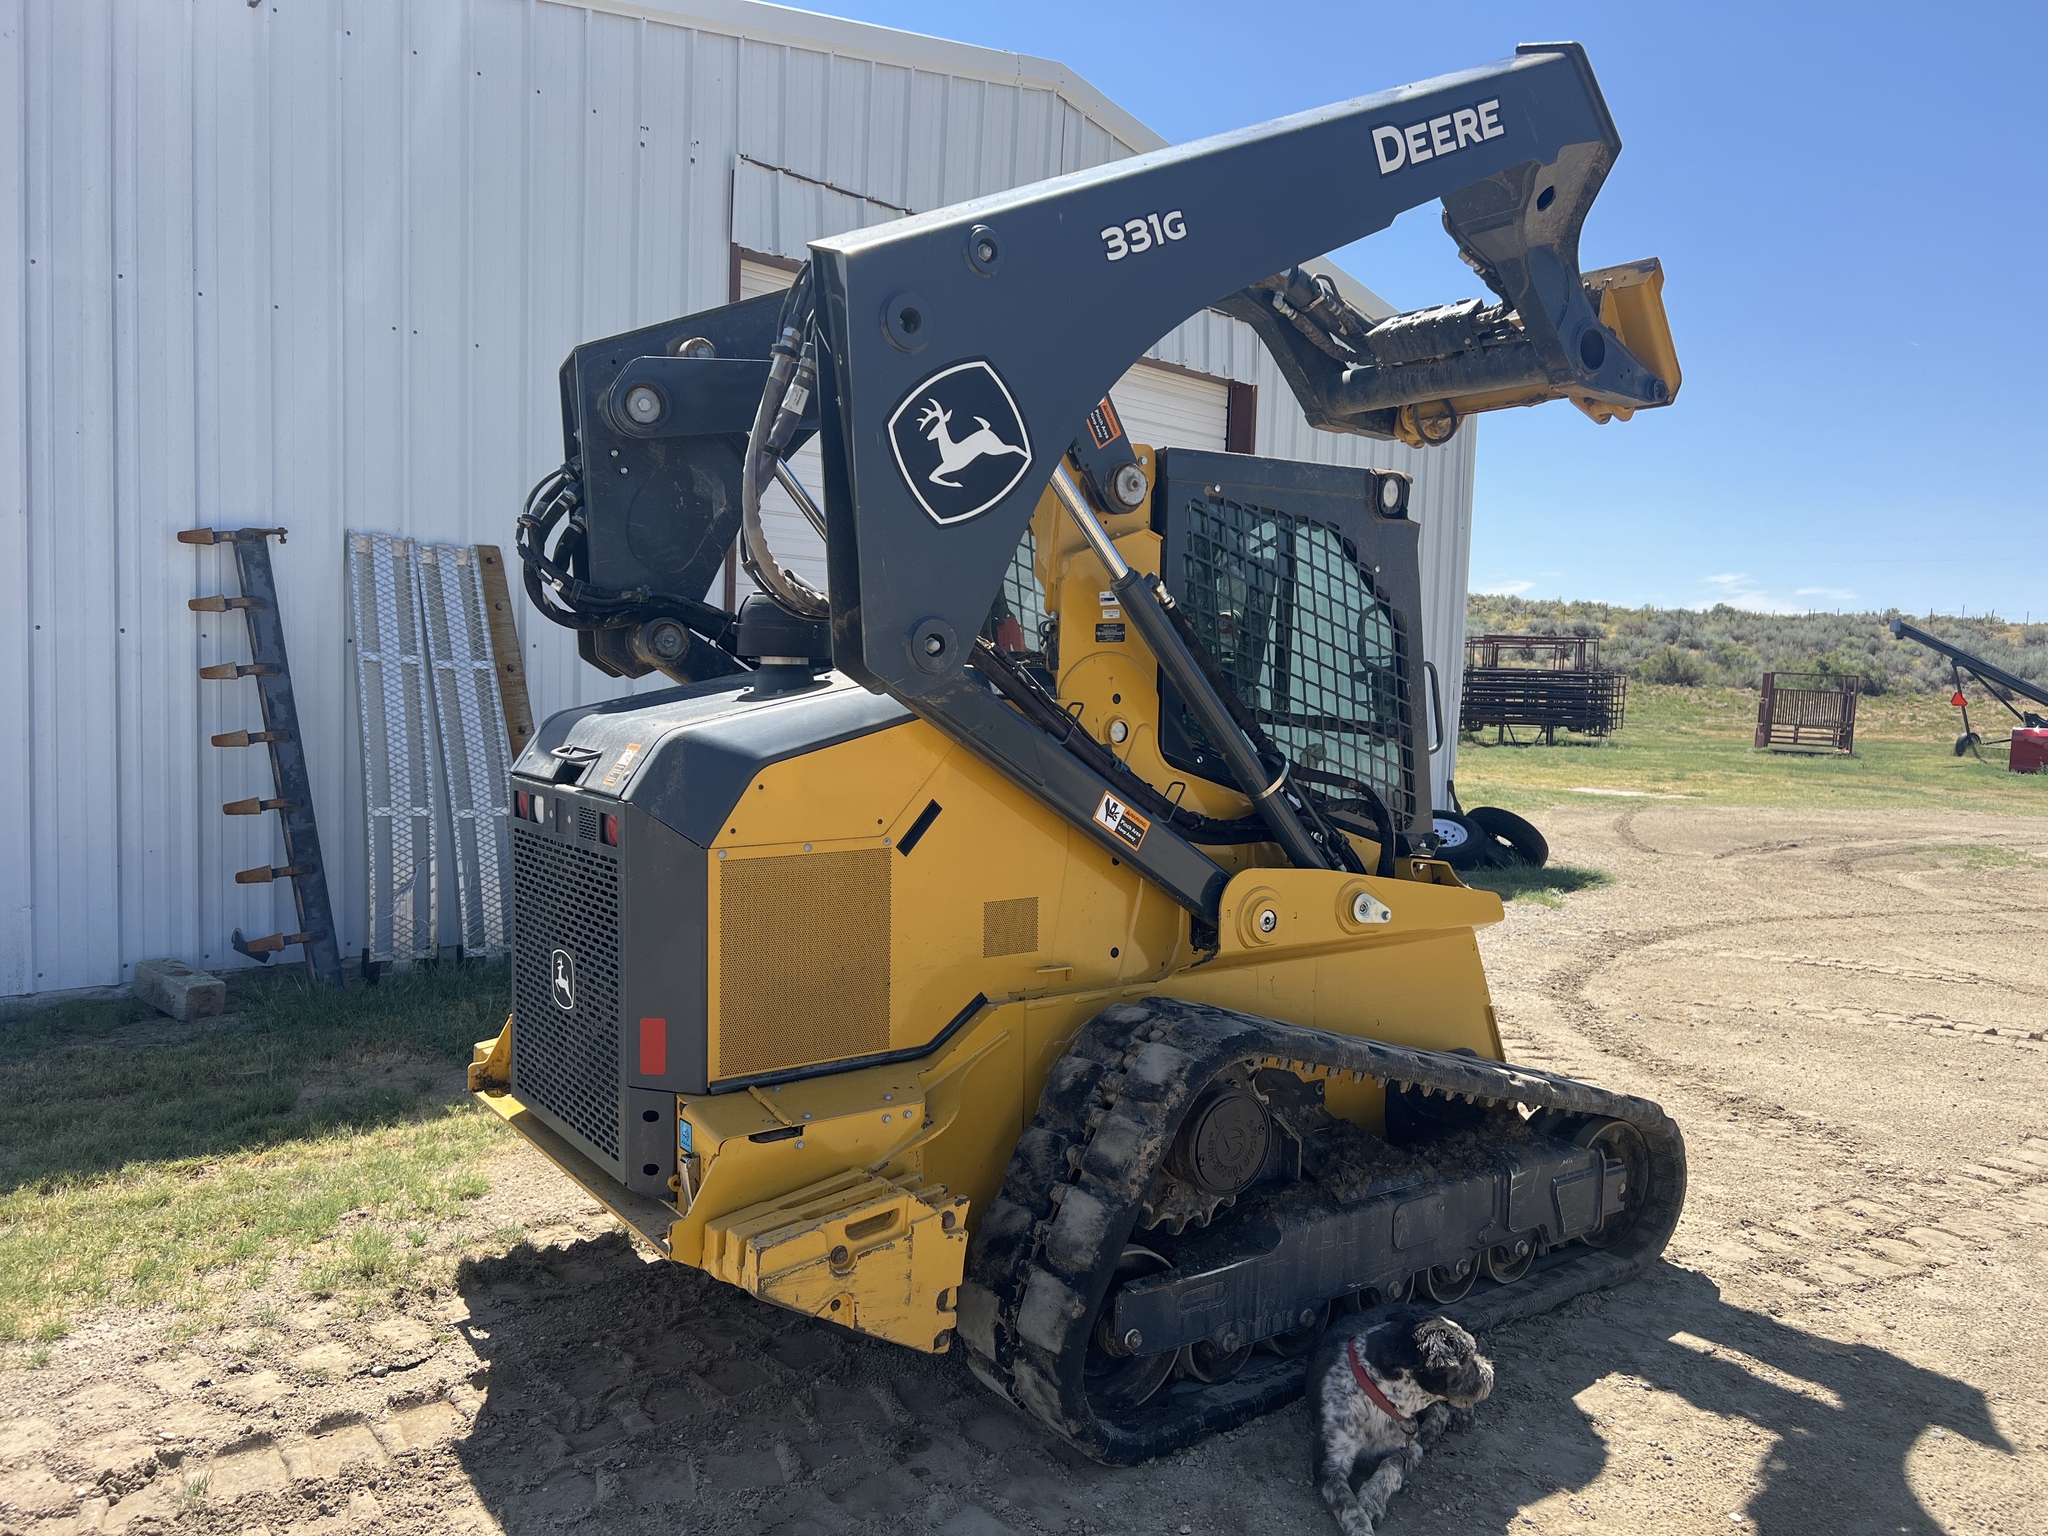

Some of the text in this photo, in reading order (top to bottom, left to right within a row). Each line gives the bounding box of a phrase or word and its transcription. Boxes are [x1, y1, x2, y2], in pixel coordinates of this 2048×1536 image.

[1371, 98, 1505, 175] DEERE
[1101, 210, 1188, 261] 331G
[1094, 409, 1110, 439] Pinch Area
[1095, 425, 1103, 438] Away
[1120, 819, 1142, 838] Pinch Area
[1129, 812, 1147, 828] WARNING
[1117, 826, 1136, 842] Keep Away
[1244, 1118, 1258, 1168] SPICER
